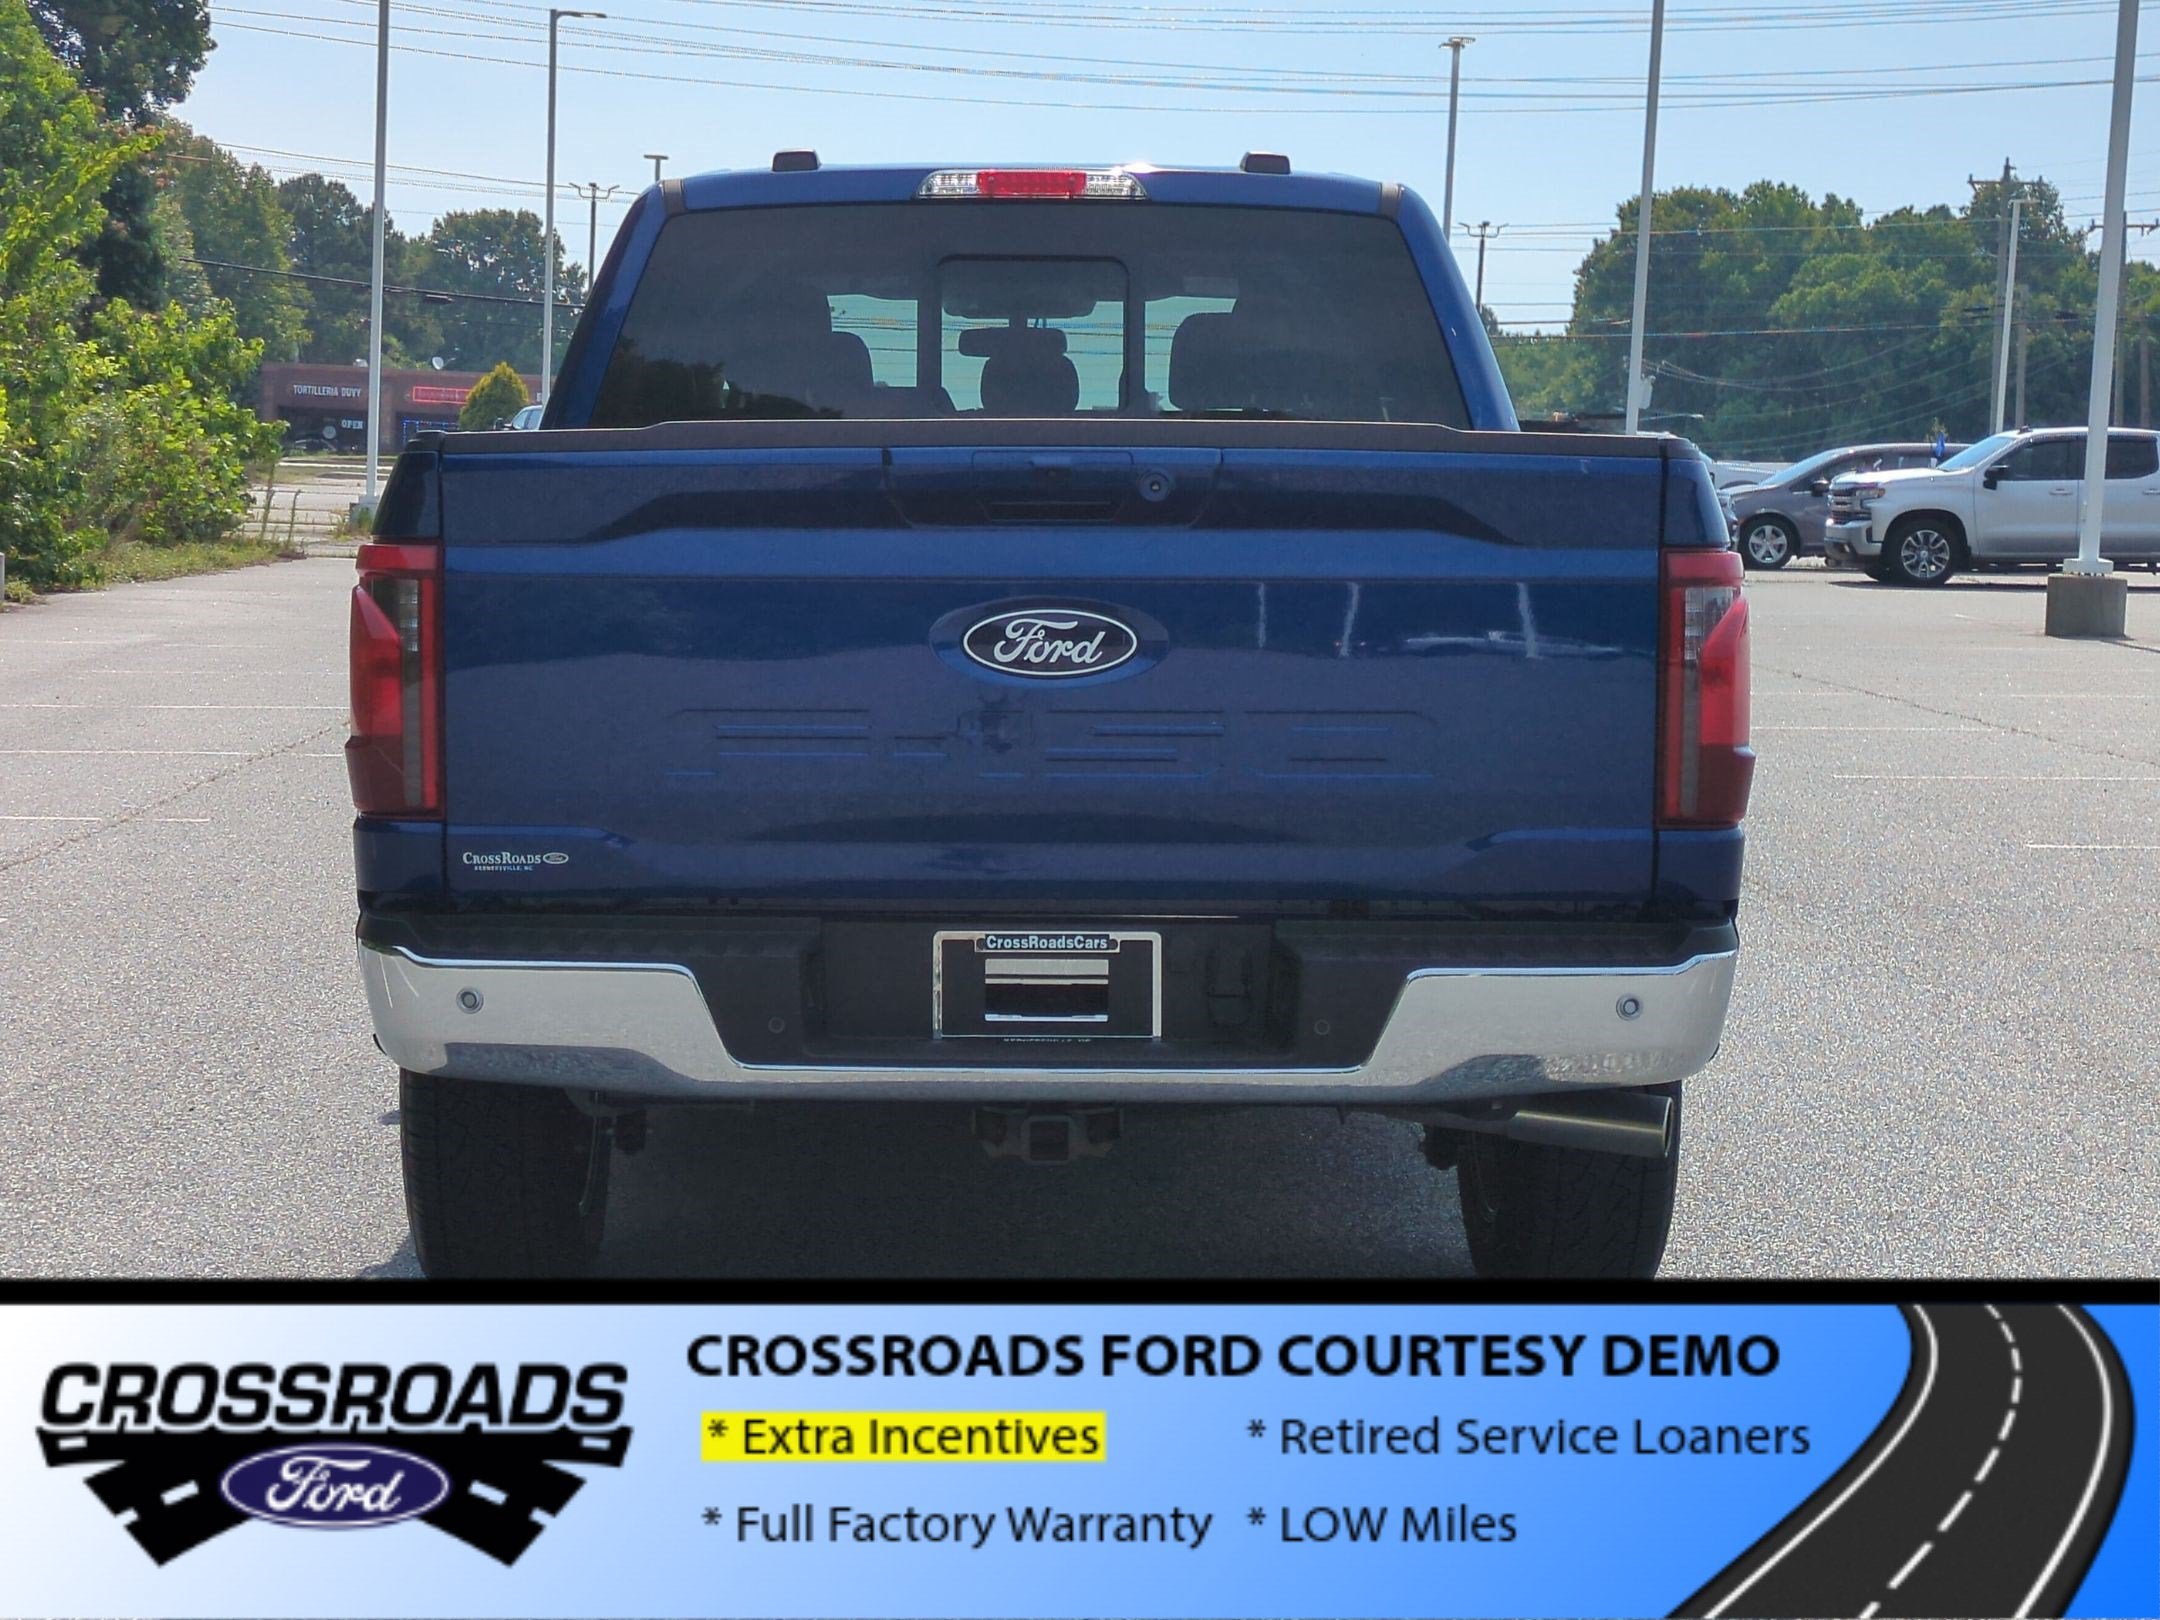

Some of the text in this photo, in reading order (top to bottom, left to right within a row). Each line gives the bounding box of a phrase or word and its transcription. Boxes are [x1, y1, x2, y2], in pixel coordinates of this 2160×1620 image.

[293, 384, 339, 397] TORTILLERIA
[341, 419, 364, 430] OPEN
[993, 617, 1107, 665] Ford
[986, 934, 1109, 950] CrossRoadsCars
